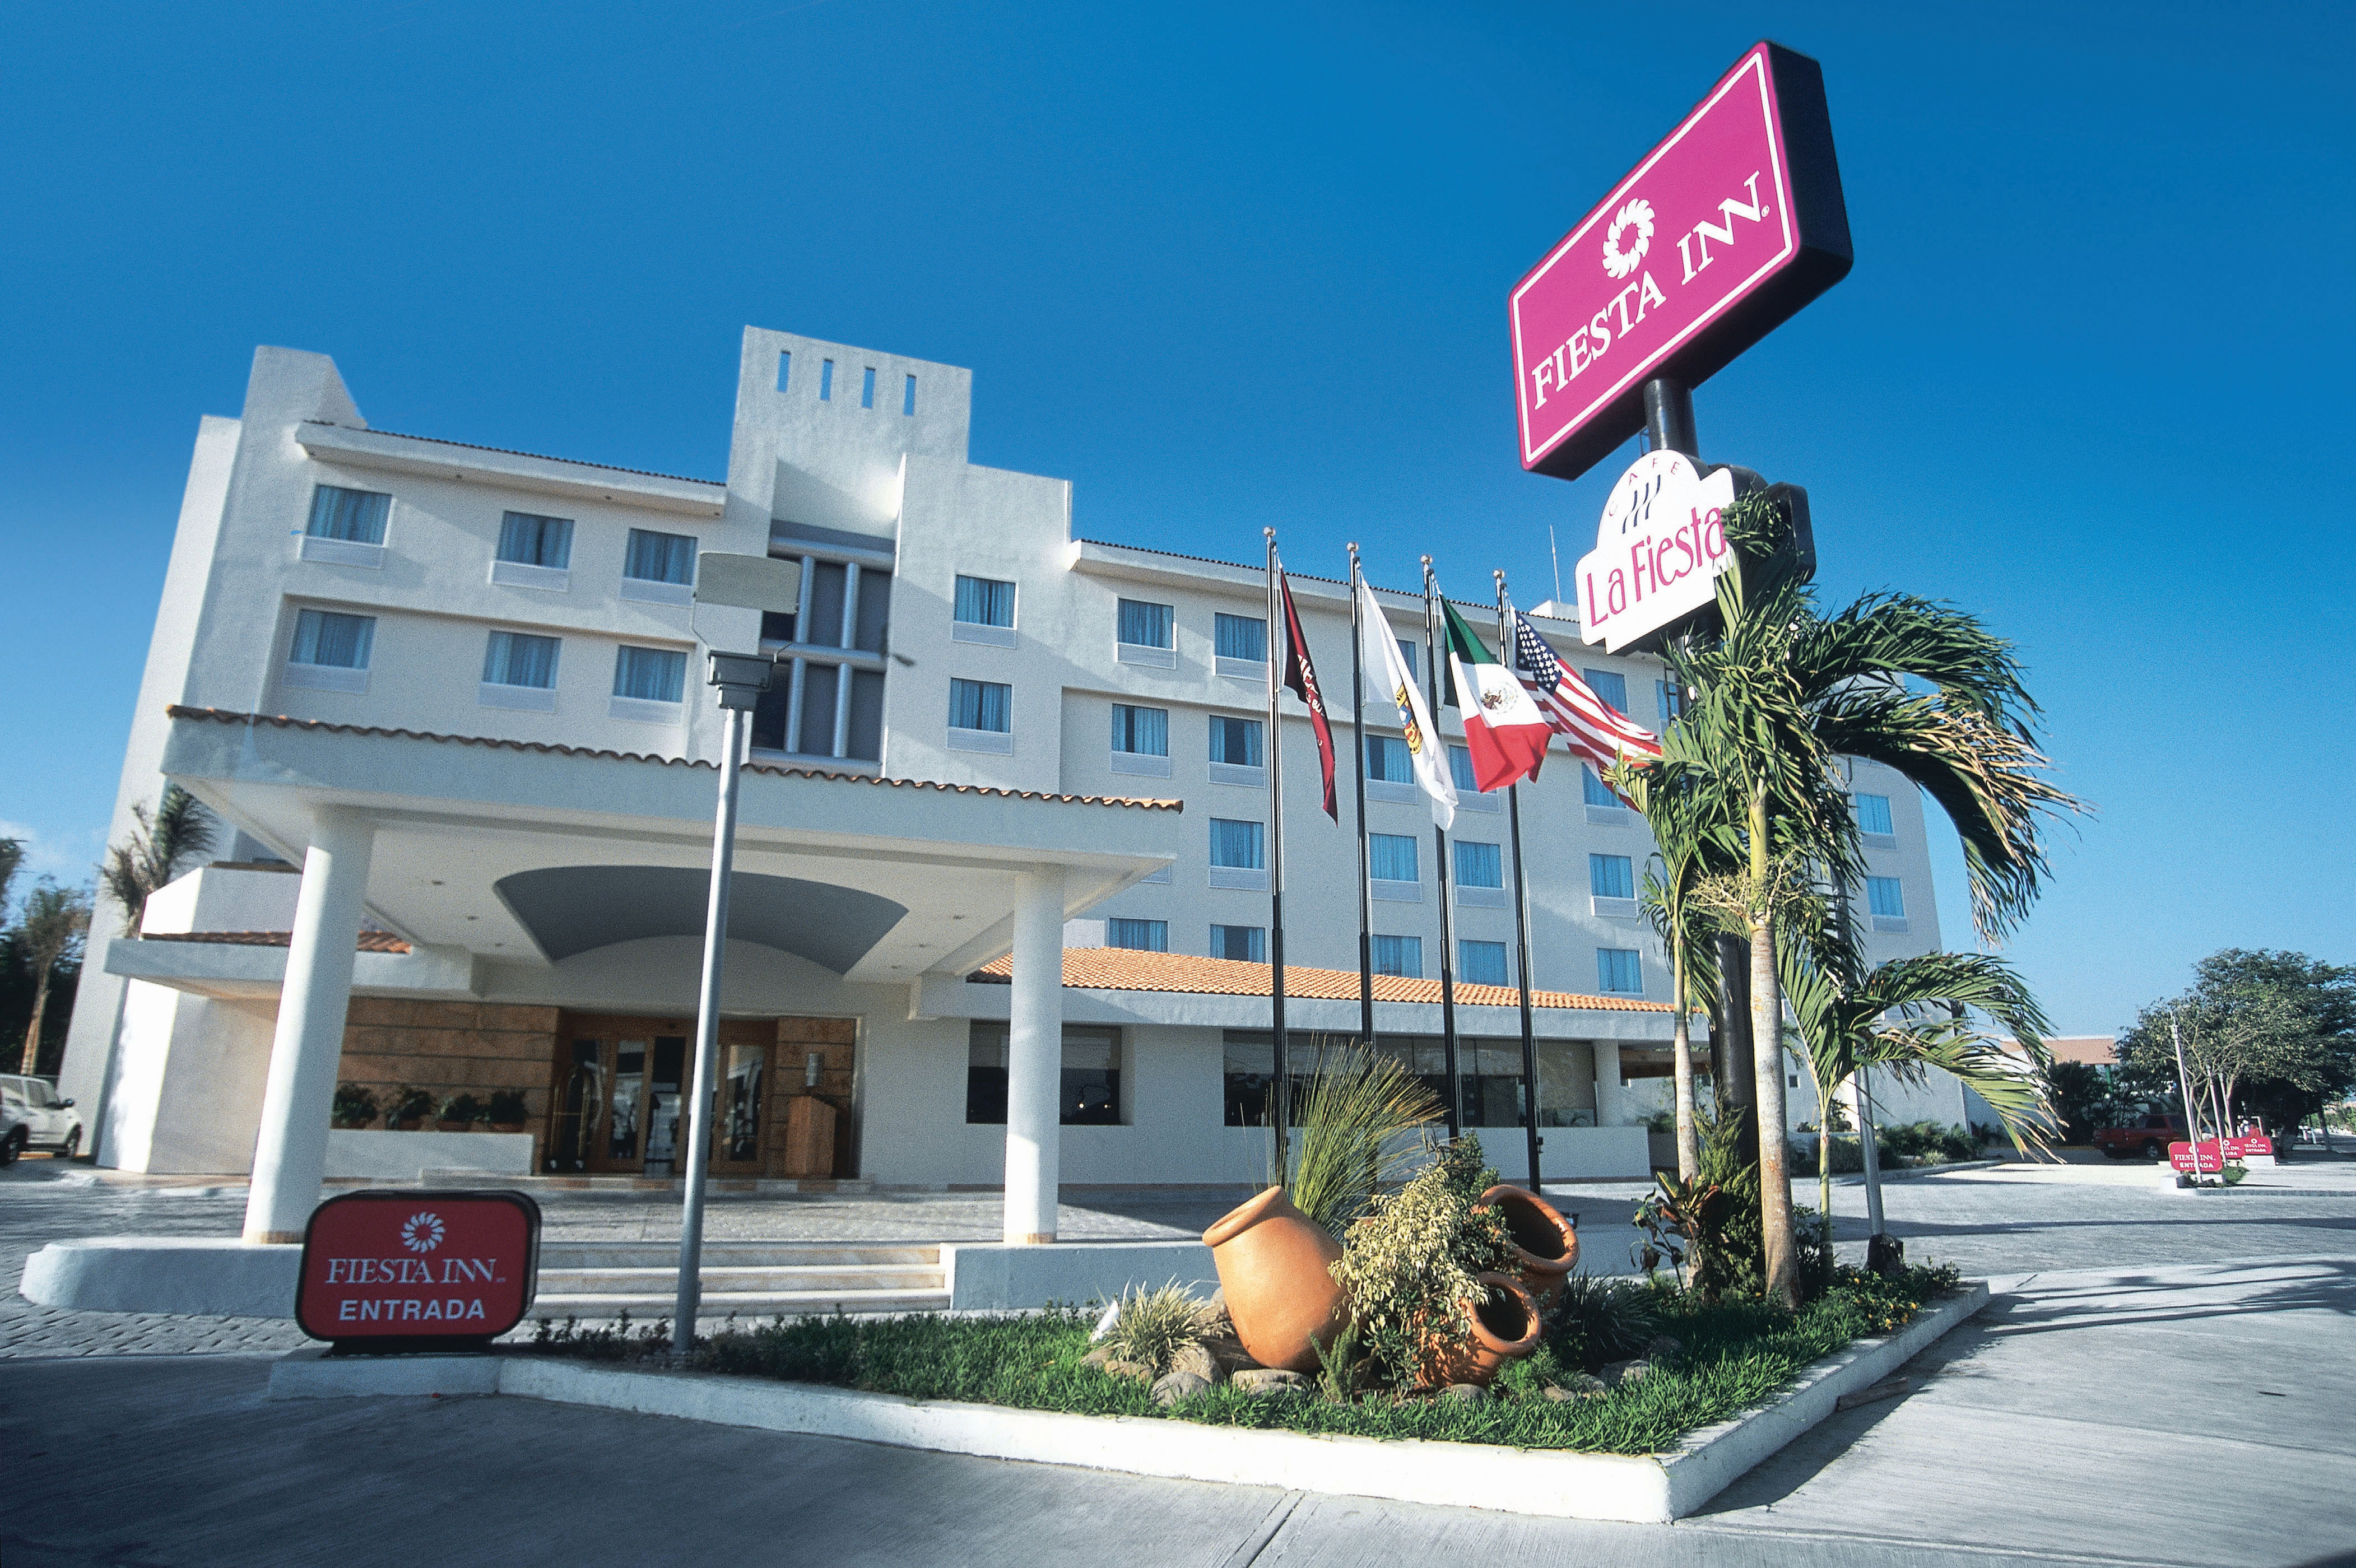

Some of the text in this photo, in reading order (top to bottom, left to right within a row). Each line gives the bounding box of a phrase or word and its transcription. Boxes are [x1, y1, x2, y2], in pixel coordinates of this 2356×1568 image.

[1531, 170, 1762, 410] FIESTA INN
[1587, 506, 1727, 627] La Fiesta
[325, 1258, 497, 1284] FIESTA INN
[339, 1298, 486, 1321] ENTRADA
